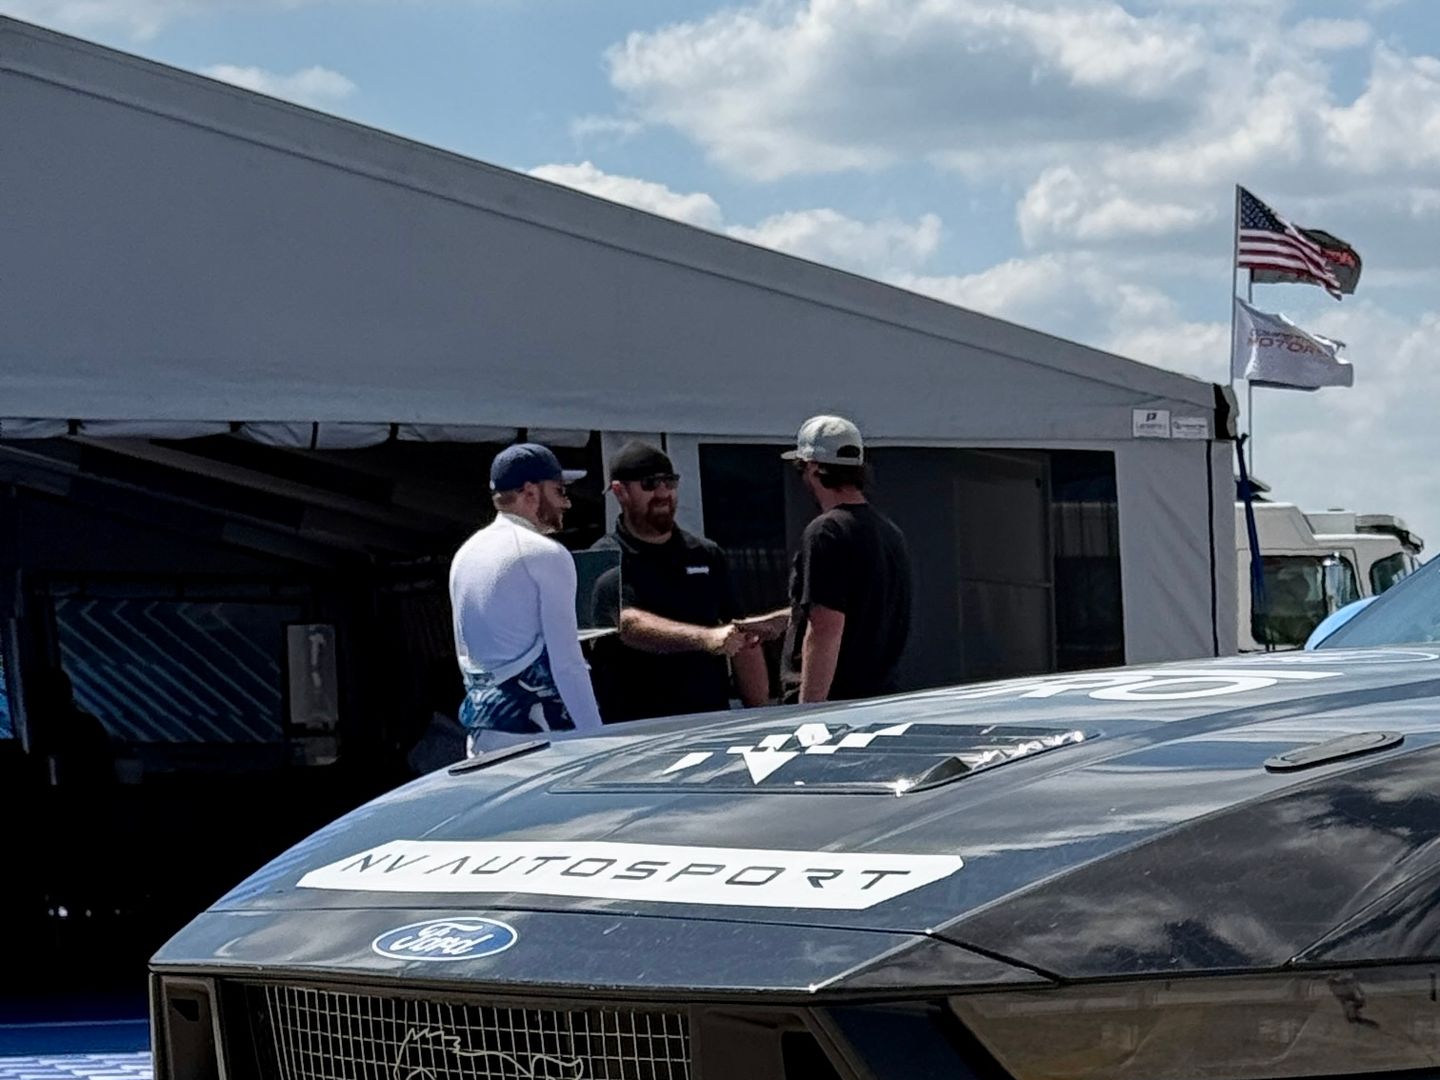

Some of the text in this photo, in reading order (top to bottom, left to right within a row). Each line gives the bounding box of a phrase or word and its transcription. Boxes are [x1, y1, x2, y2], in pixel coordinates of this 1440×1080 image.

[340, 853, 912, 890] NV AUTOSPORT
[391, 919, 500, 958] Ford
